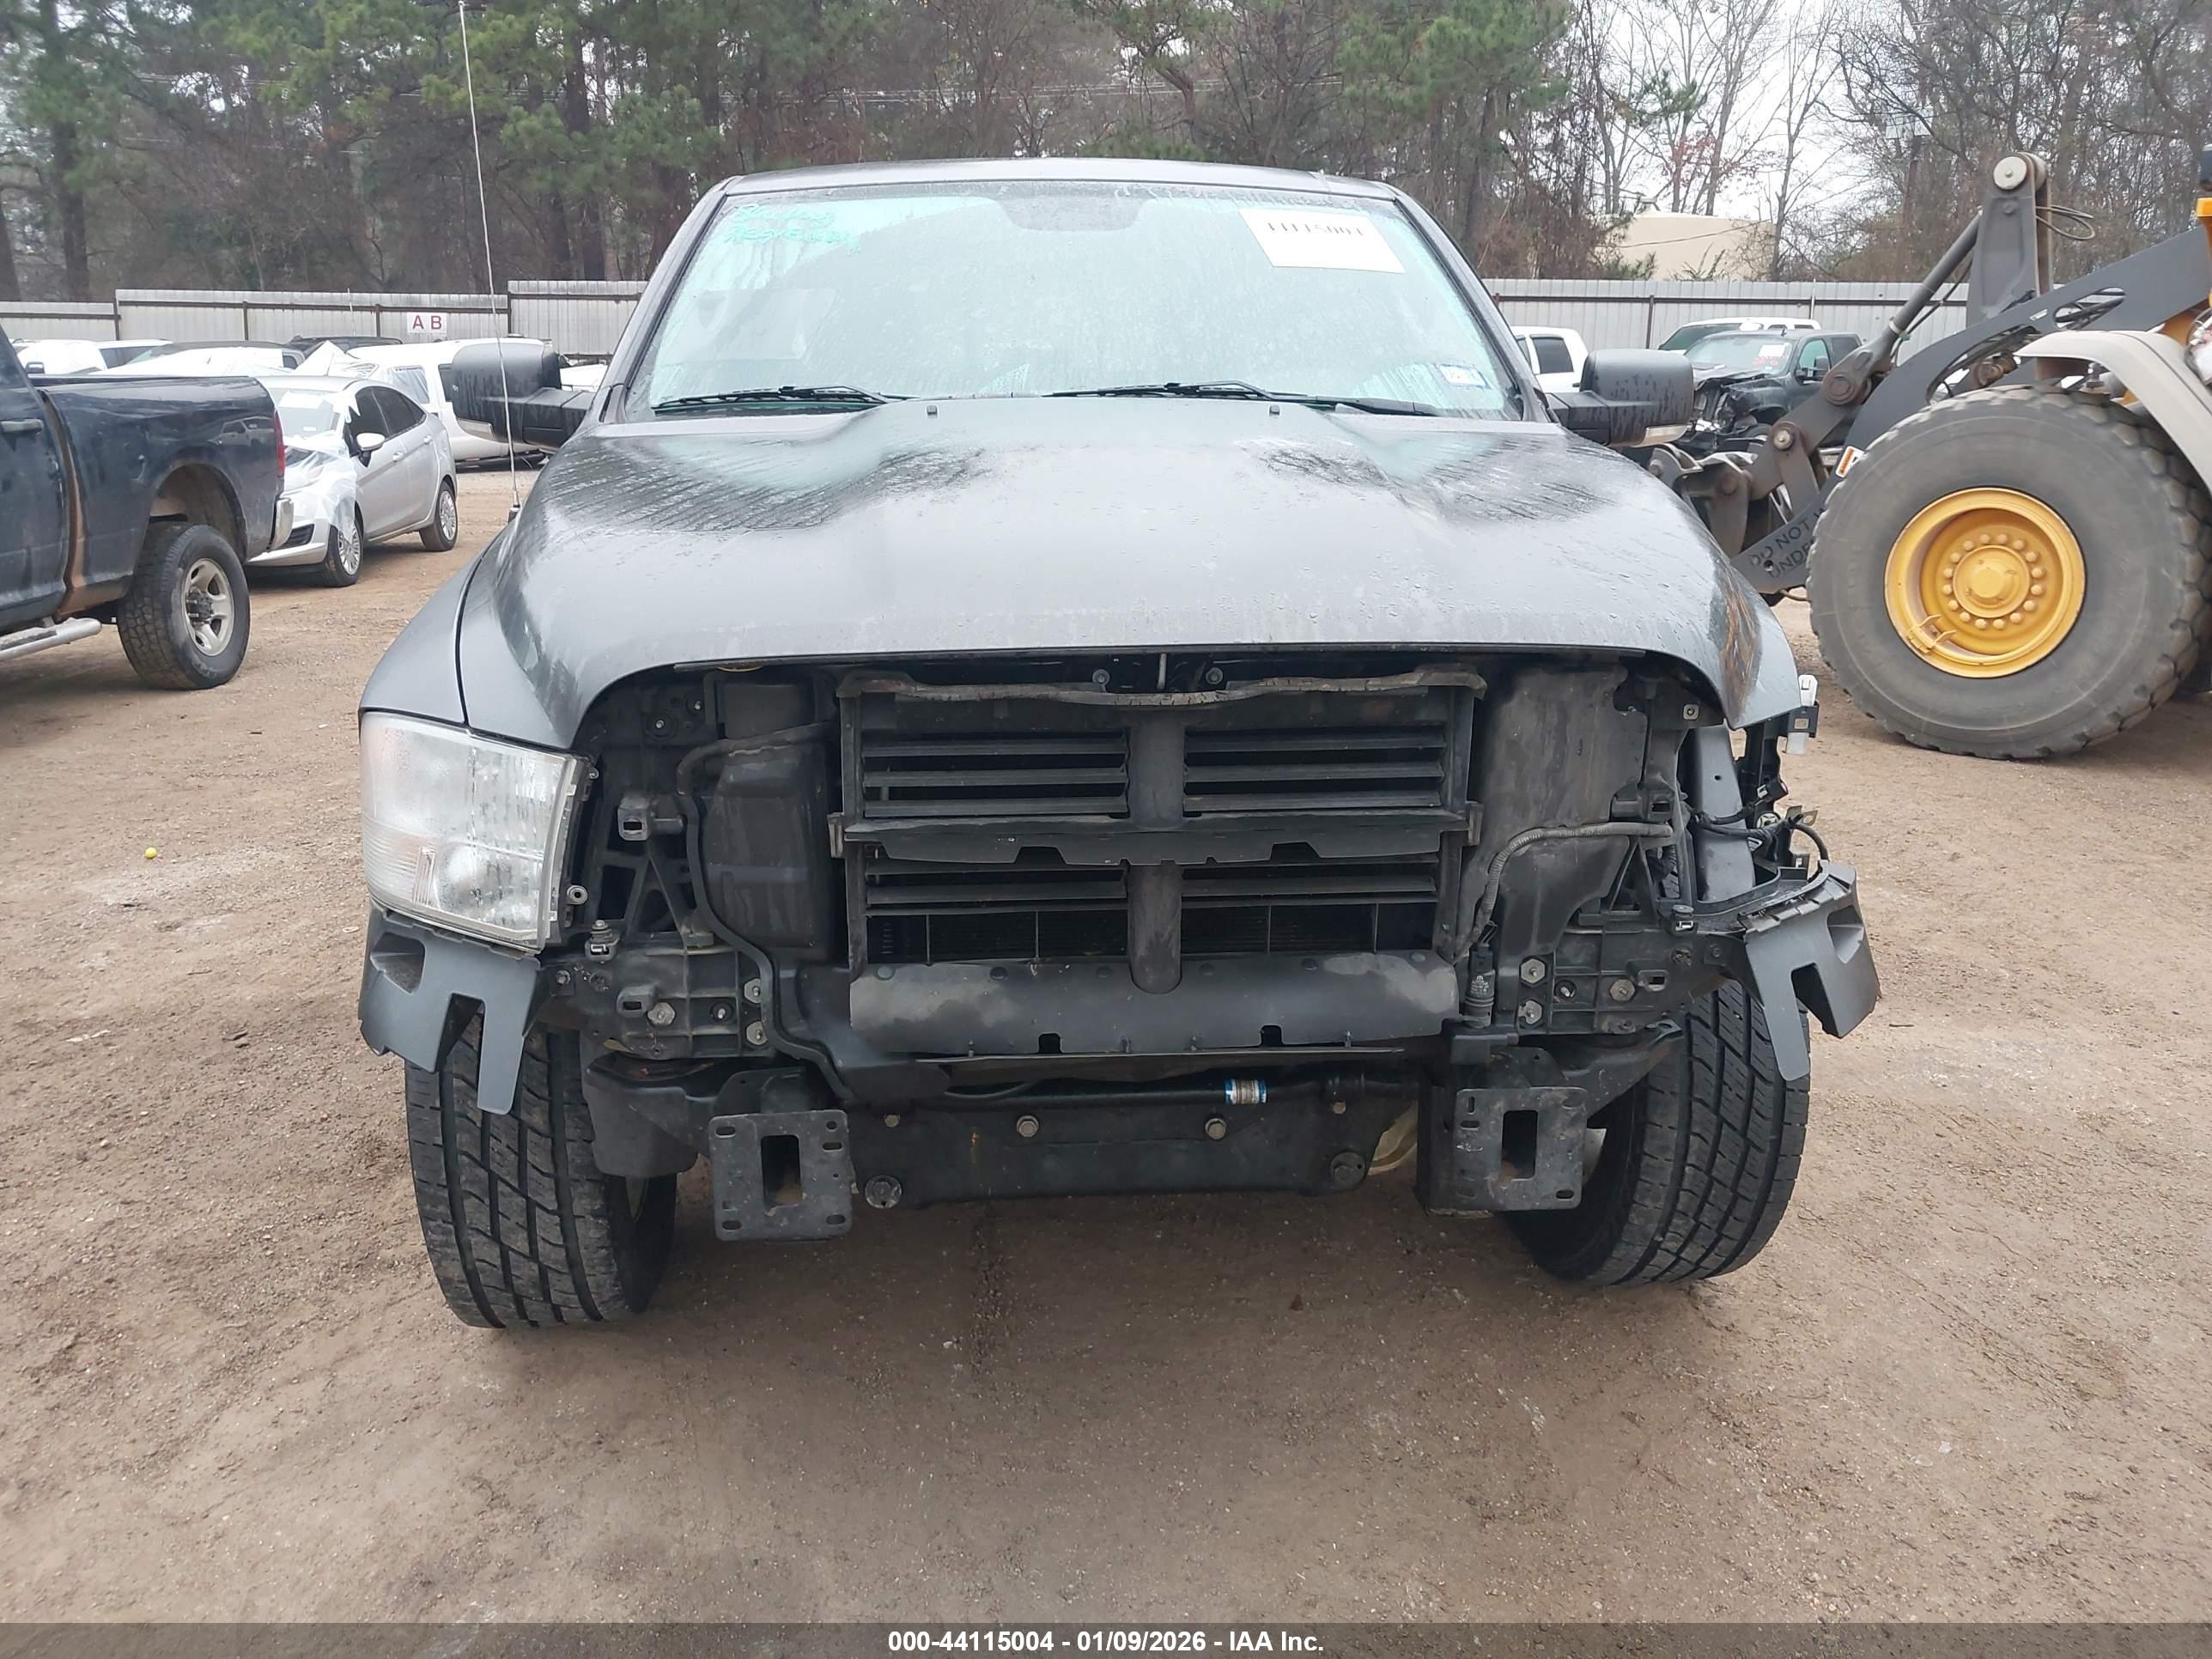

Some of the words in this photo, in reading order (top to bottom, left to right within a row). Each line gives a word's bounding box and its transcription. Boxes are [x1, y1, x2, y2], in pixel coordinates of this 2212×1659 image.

[412, 314, 424, 330] A
[430, 315, 442, 330] B
[1747, 545, 1773, 567] DO
[1775, 517, 1810, 550] NOT
